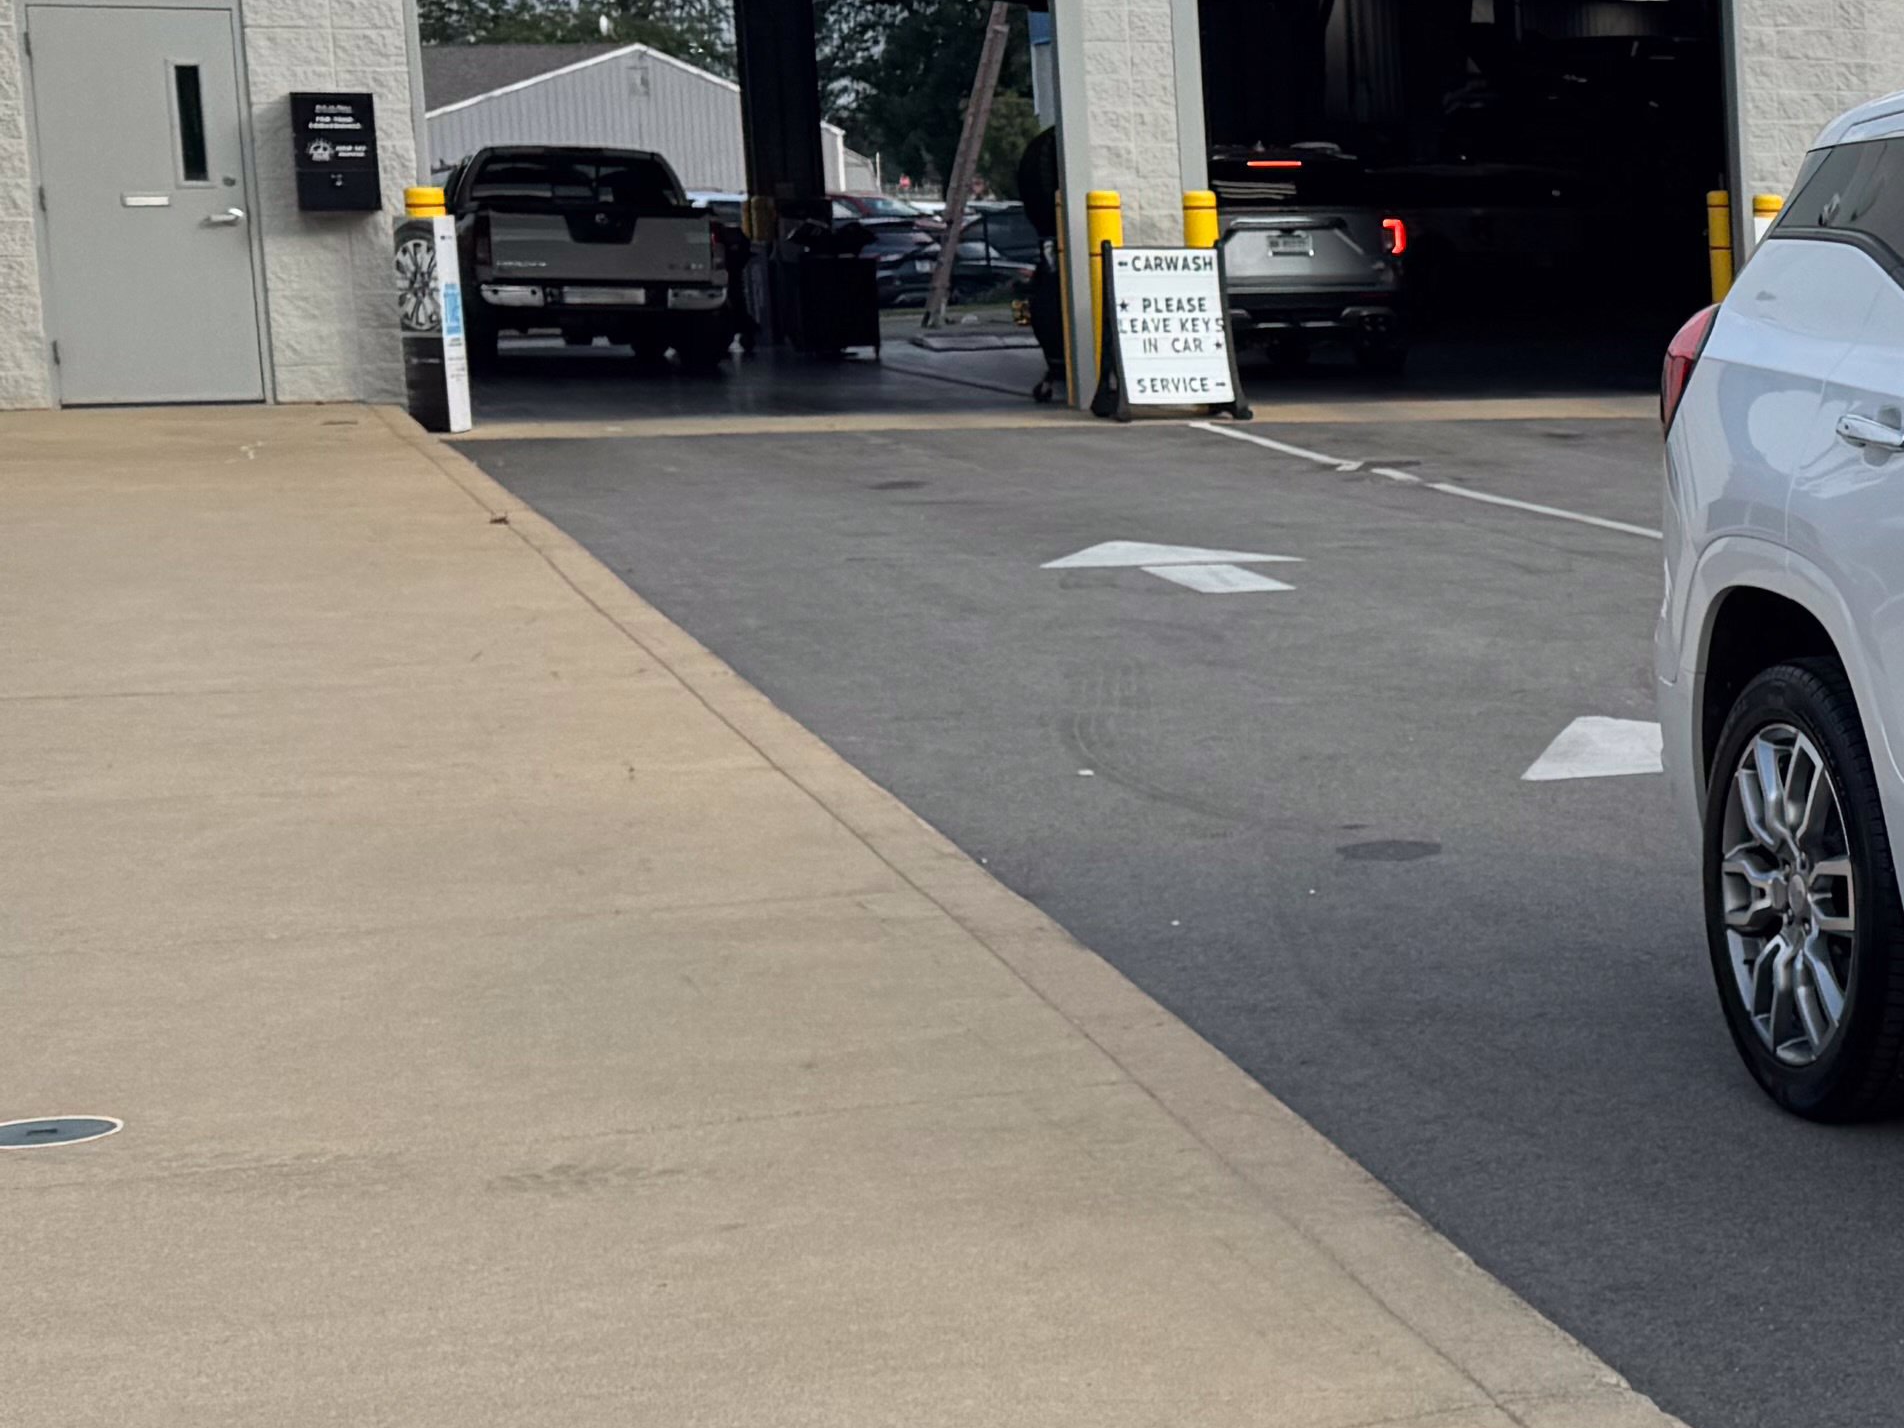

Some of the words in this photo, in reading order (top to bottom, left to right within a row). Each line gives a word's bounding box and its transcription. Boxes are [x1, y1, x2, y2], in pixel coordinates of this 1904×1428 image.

[1132, 256, 1213, 272] CARWASH
[1142, 297, 1207, 314] PLEASE
[1118, 318, 1171, 333] LEAVE
[1180, 317, 1225, 333] KEYS
[1143, 338, 1158, 353] IN
[1171, 338, 1204, 353] CAR
[1137, 377, 1210, 393] SERVICE
